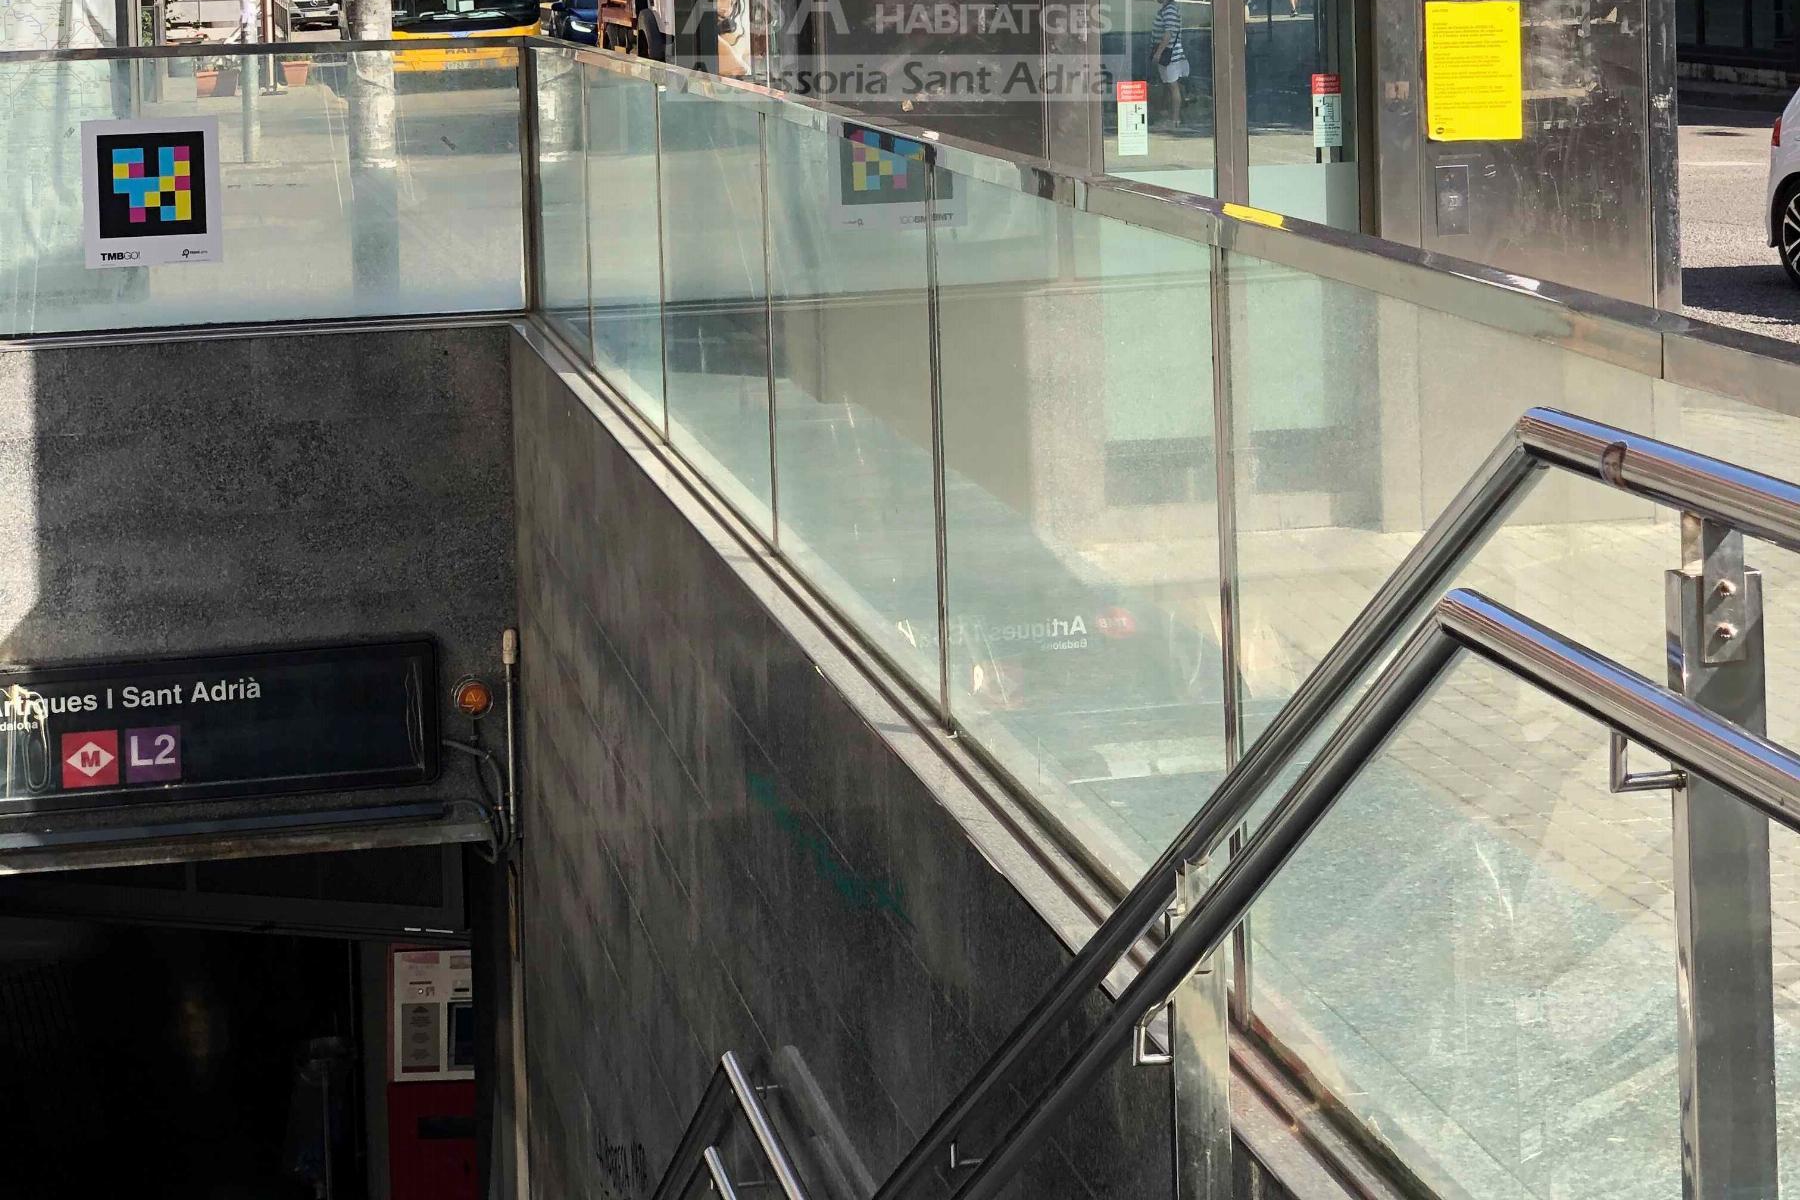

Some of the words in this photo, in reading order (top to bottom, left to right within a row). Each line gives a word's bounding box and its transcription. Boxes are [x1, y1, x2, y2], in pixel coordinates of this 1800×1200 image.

[122, 684, 182, 708] Sant
[191, 677, 261, 703] Adrià
[80, 750, 100, 768] M
[130, 734, 176, 767] L2
